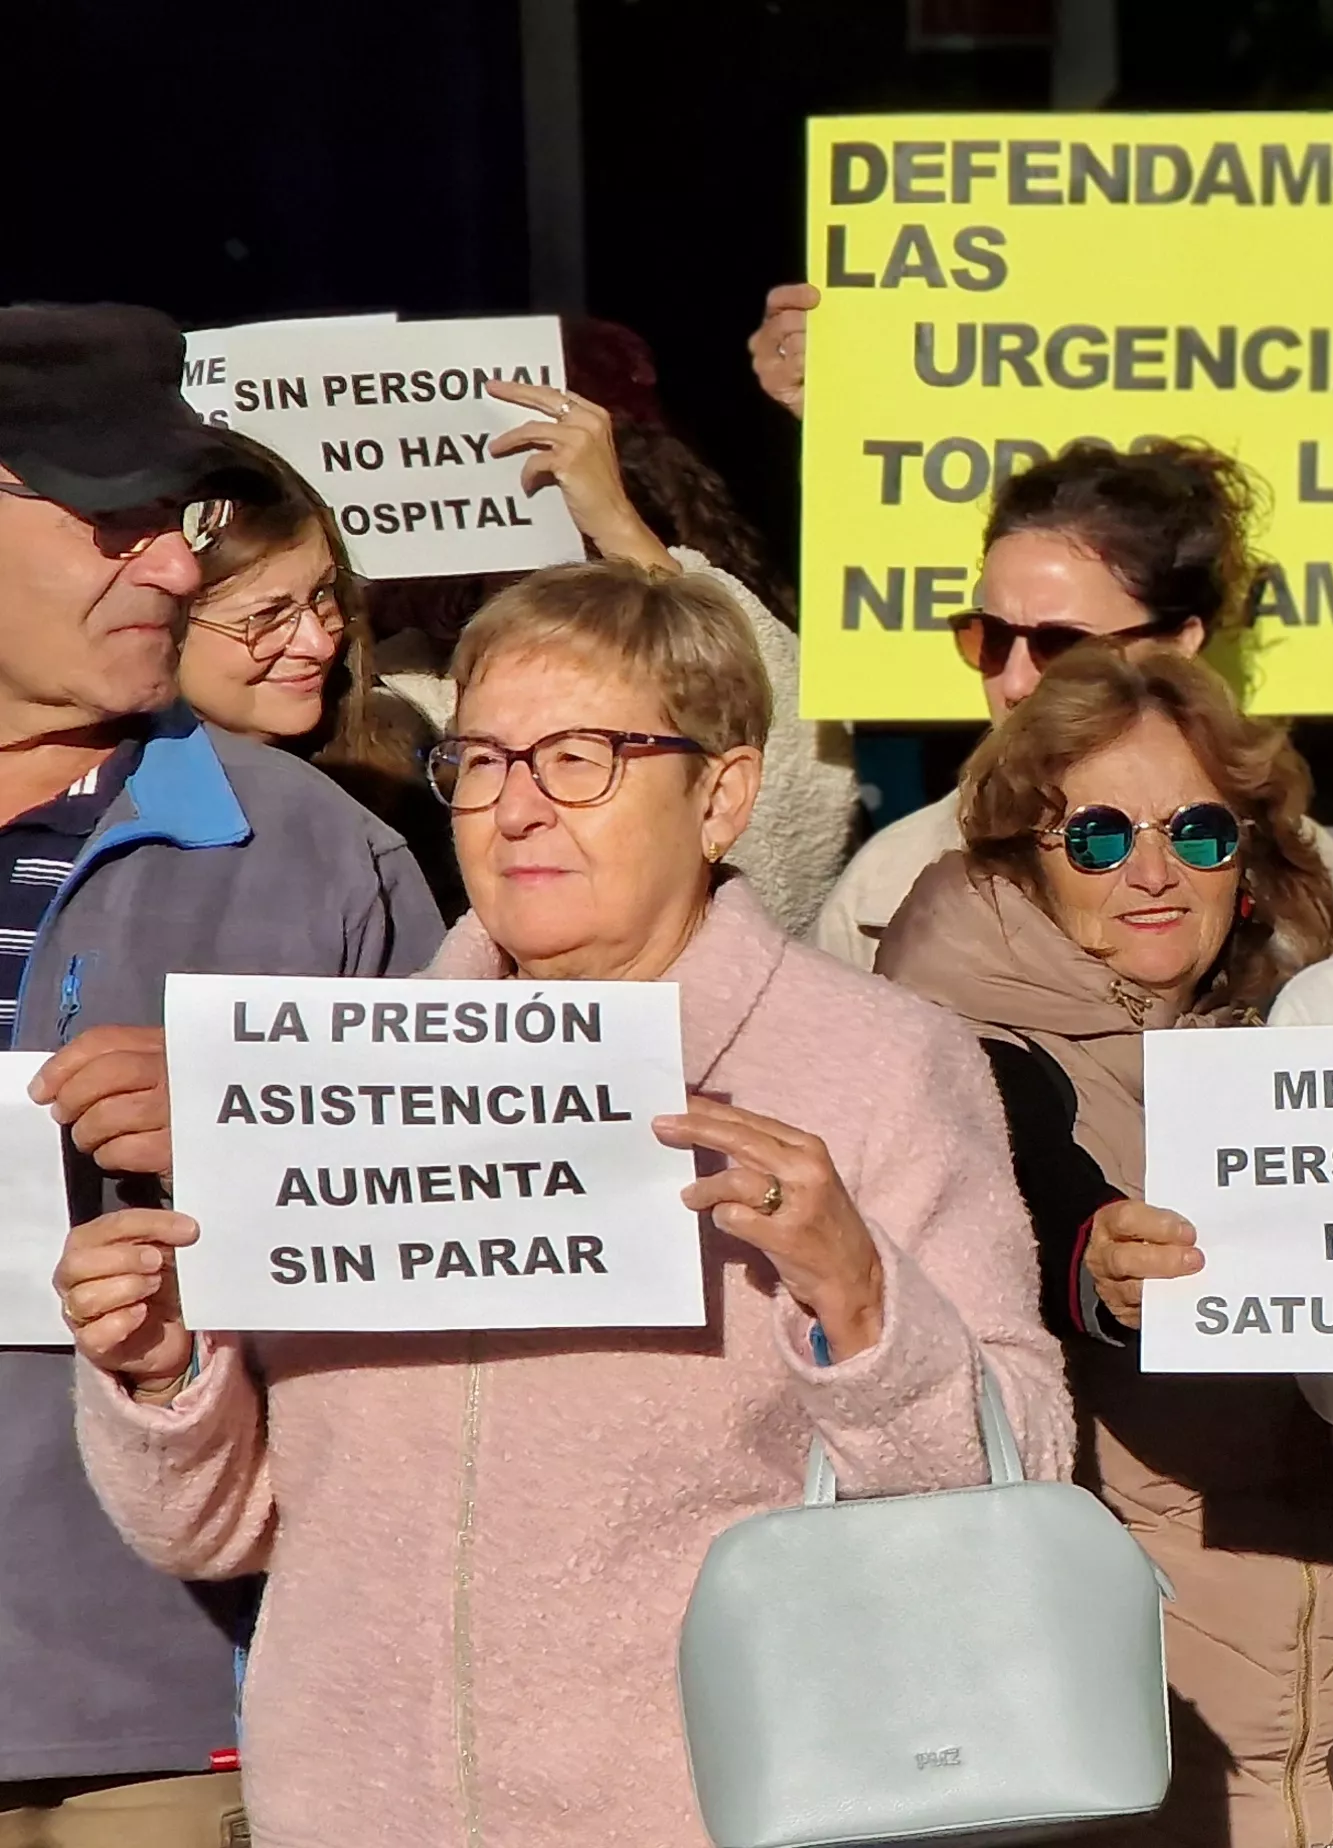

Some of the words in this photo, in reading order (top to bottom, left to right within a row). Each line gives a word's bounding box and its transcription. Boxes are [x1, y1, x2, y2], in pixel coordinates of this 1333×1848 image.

[825, 223, 1008, 292] LAS
[234, 375, 308, 412] SIN
[321, 439, 384, 472] NO
[399, 432, 490, 468] HAY
[339, 496, 533, 536] OSPITAL
[233, 1000, 309, 1043] LA
[331, 992, 603, 1044] PRESIÓN
[217, 1083, 632, 1126] ASISTENCIAL
[276, 1160, 587, 1208] AUMENTA
[270, 1244, 376, 1285] SIN
[400, 1235, 608, 1281] PARAR
